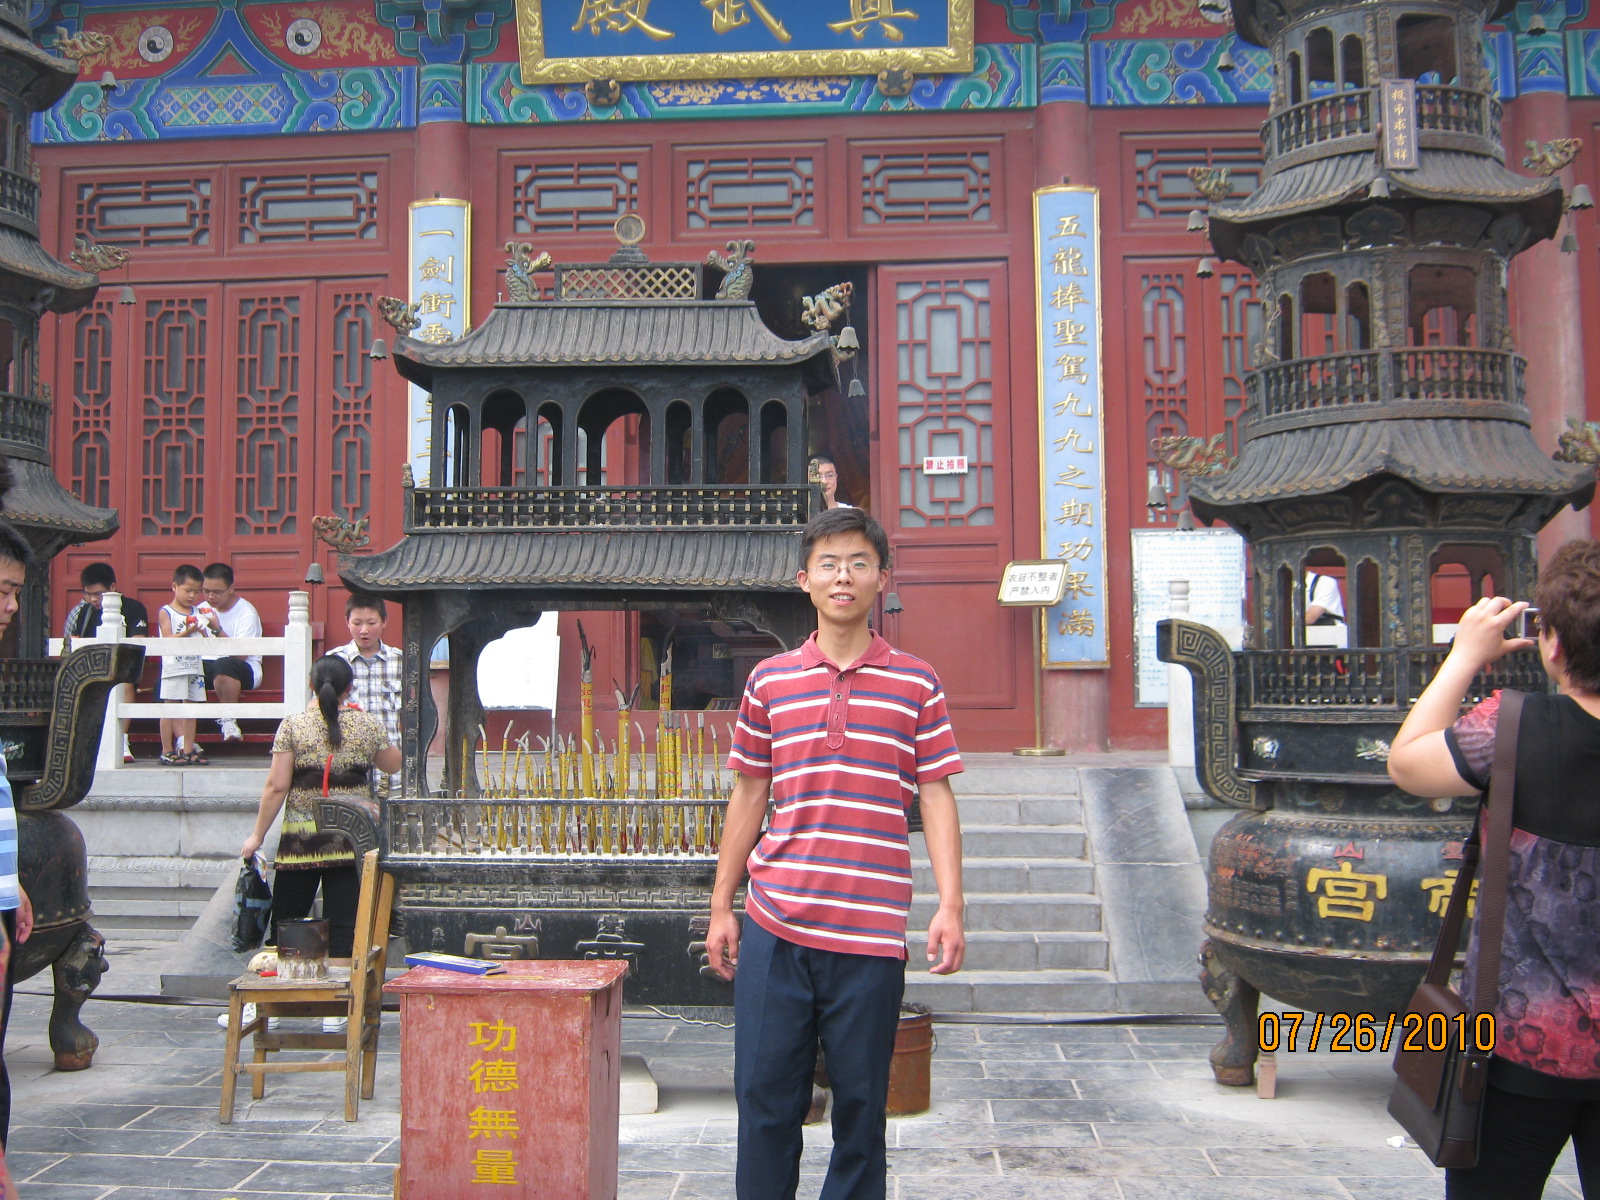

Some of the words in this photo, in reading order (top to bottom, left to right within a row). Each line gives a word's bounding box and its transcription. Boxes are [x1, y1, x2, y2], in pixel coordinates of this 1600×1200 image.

[1008, 572, 1058, 583] 衣冠不整者
[1009, 586, 1050, 597] 严禁入内
[468, 1019, 520, 1185] 功德無量
